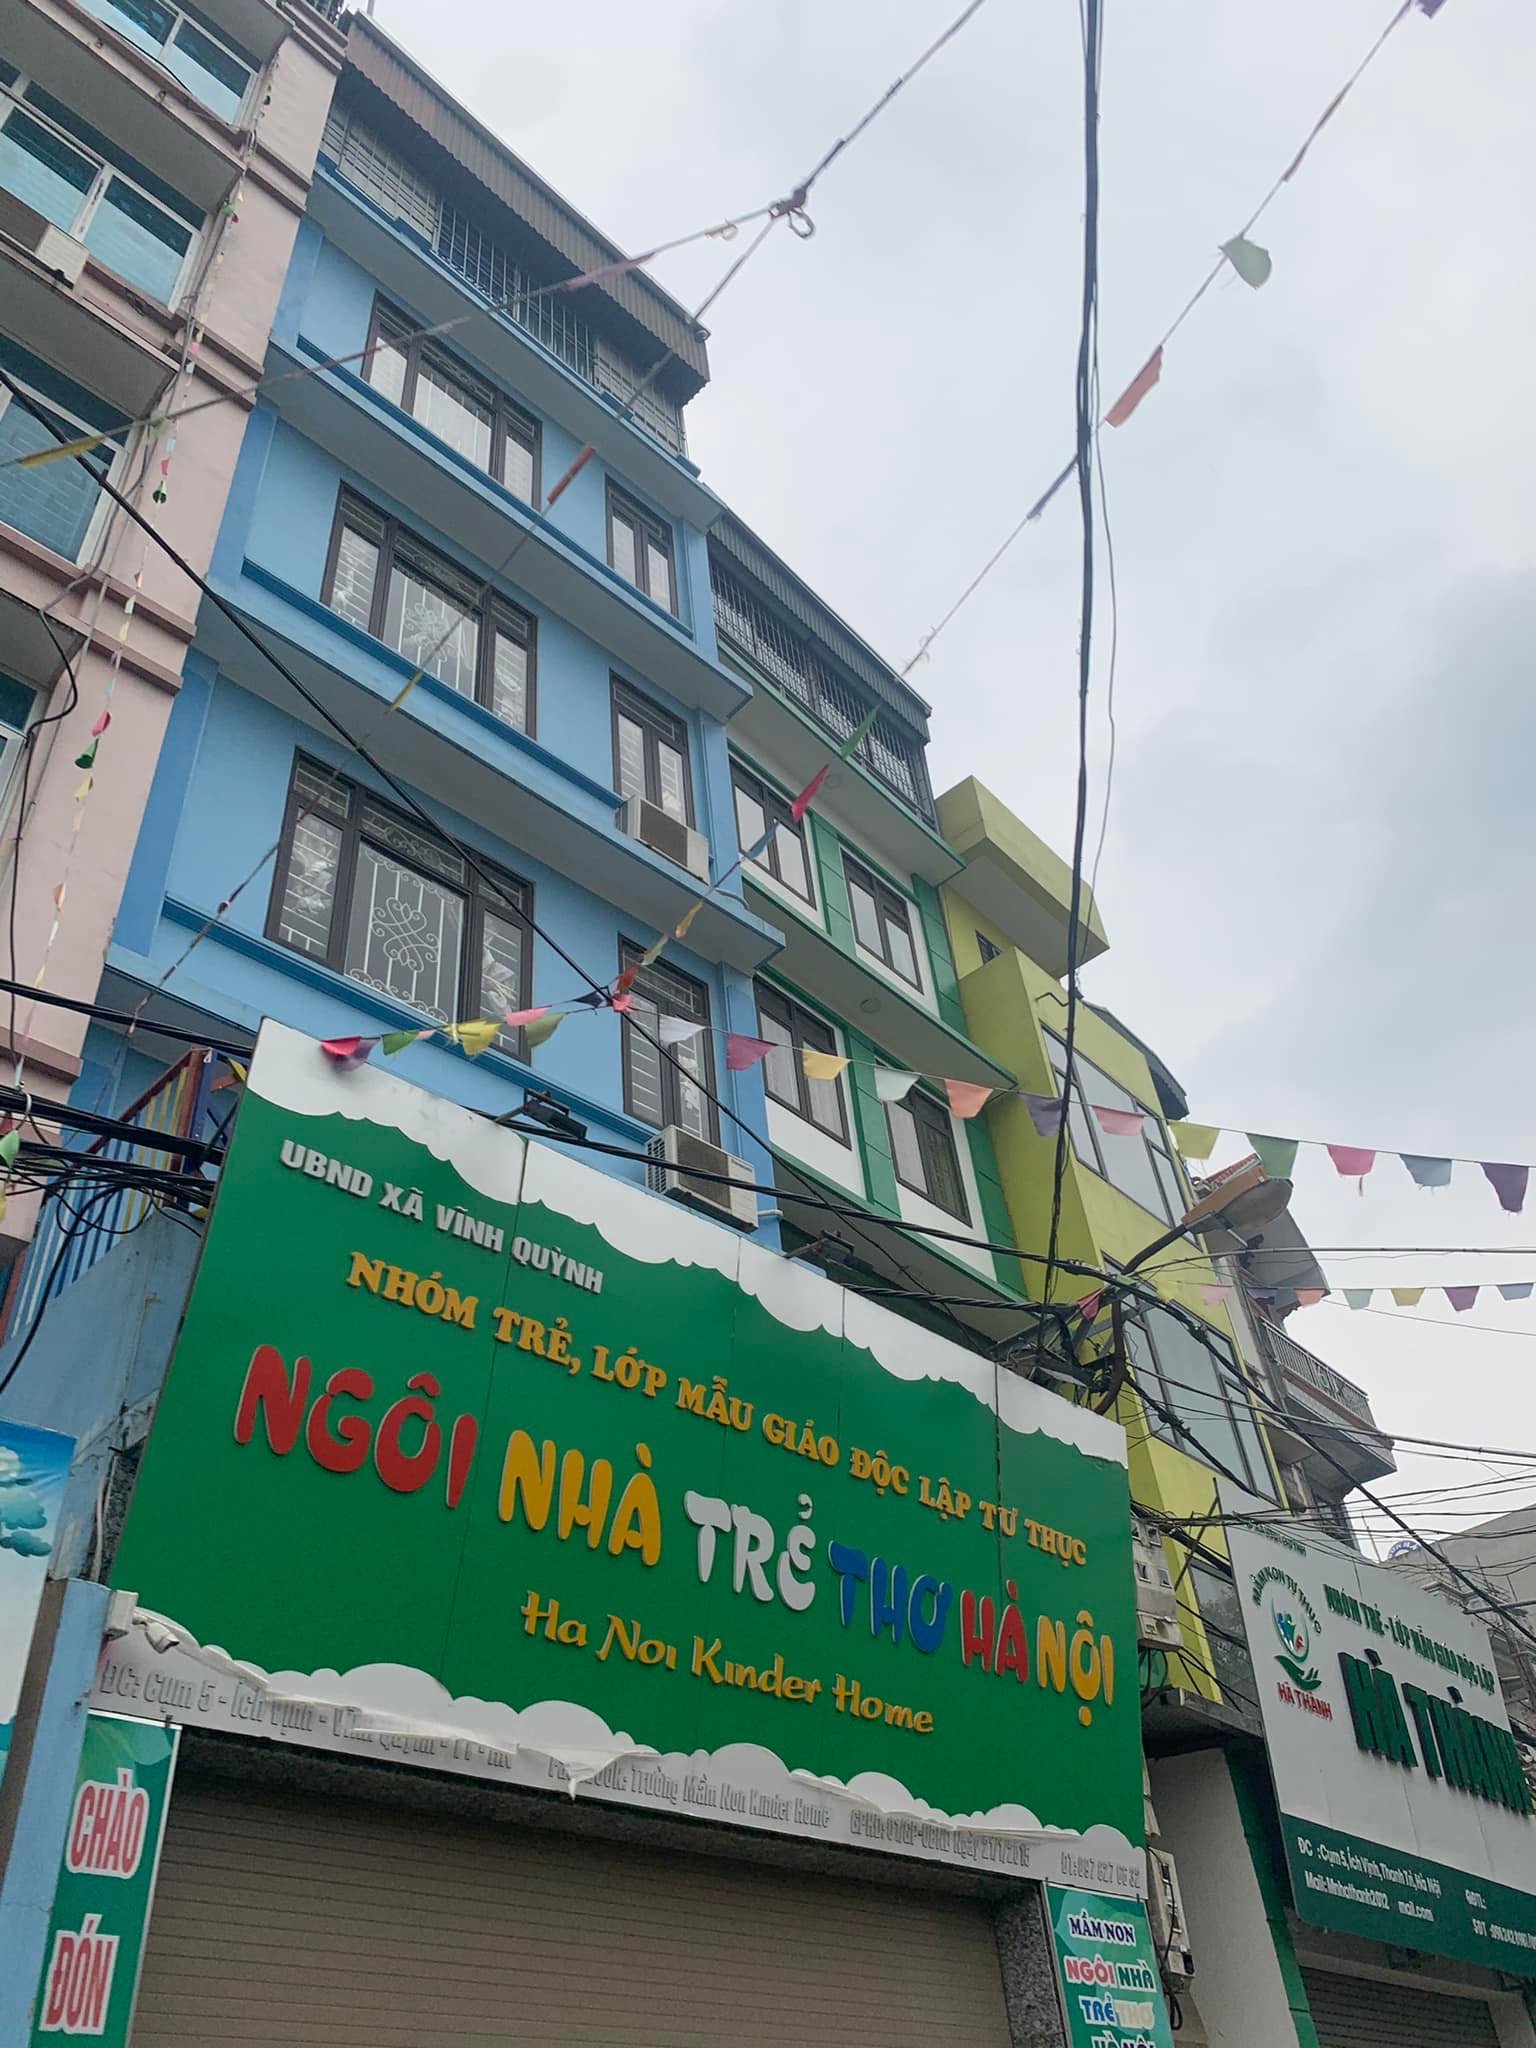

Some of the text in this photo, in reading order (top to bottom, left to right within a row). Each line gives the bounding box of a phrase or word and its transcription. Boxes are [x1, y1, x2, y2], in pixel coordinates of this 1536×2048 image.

[280, 1139, 604, 1294] UBND XÃ VĨNH QUỲNH
[346, 1252, 1087, 1568] NHÓM TRẺ, LỚP MẪU GIÁO ĐỘC LẬP TƯ THỤC
[233, 1344, 1114, 1727] NGÔI NHÀ TRẺ THƠ HÀ NỘI
[197, 1678, 216, 1713] 5
[520, 1591, 588, 1648] Ha
[832, 1672, 933, 1734] Home
[1277, 1681, 1333, 1721] HÀ THÀNH
[1338, 1648, 1533, 1816] HÀ THÀNH
[69, 1770, 146, 1875] CHÀO
[1297, 1837, 1313, 1857] ĐC
[46, 1918, 113, 2029] ĐÓN
[1066, 1957, 1154, 1990] NGÔI NHÀ
[1104, 1923, 1135, 1943] NON
[1081, 1994, 1115, 2023] TRẺ
